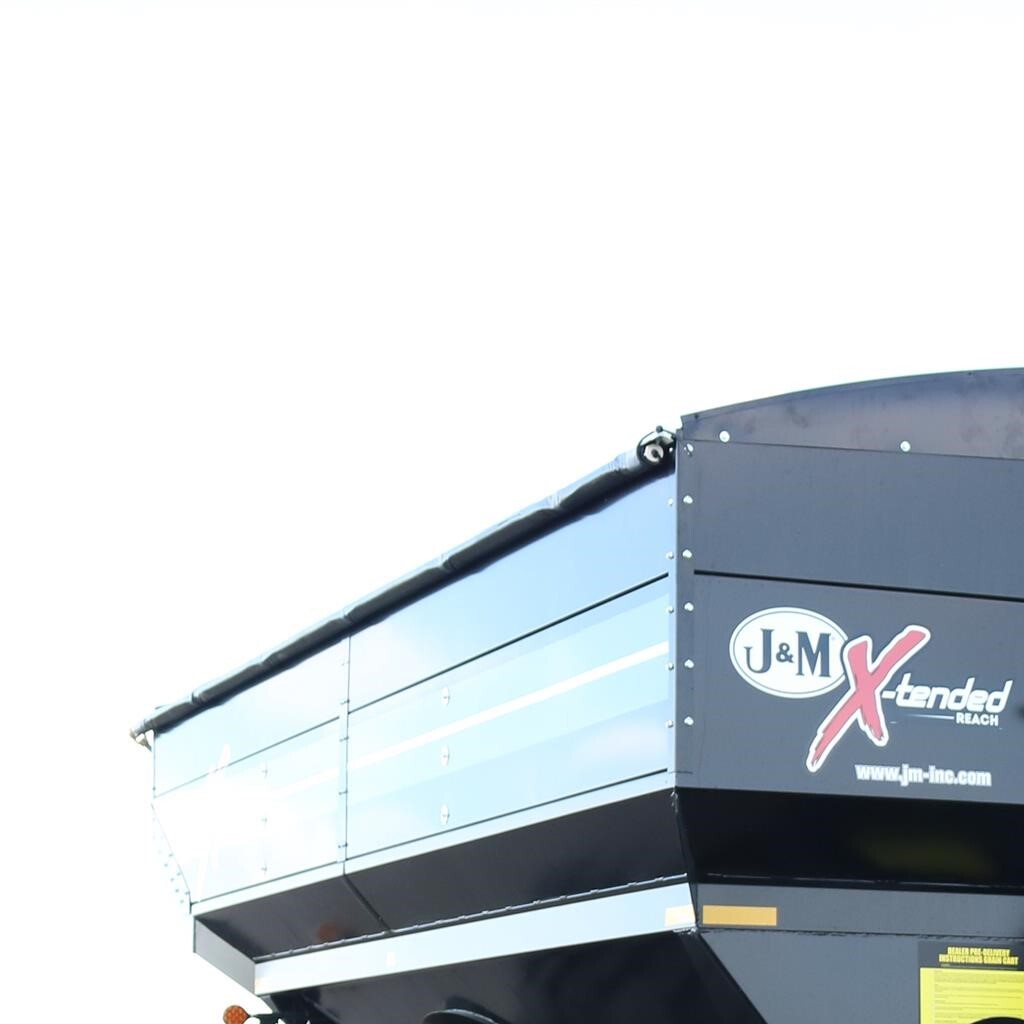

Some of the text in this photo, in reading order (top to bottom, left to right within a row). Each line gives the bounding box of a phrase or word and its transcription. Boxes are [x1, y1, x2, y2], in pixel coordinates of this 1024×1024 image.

[744, 628, 832, 678] J&M
[955, 712, 999, 727] REACH
[855, 764, 992, 787] www.jm-inc.com
[938, 954, 983, 964] INSTRUCTIONS
[1002, 956, 1019, 966] CART
